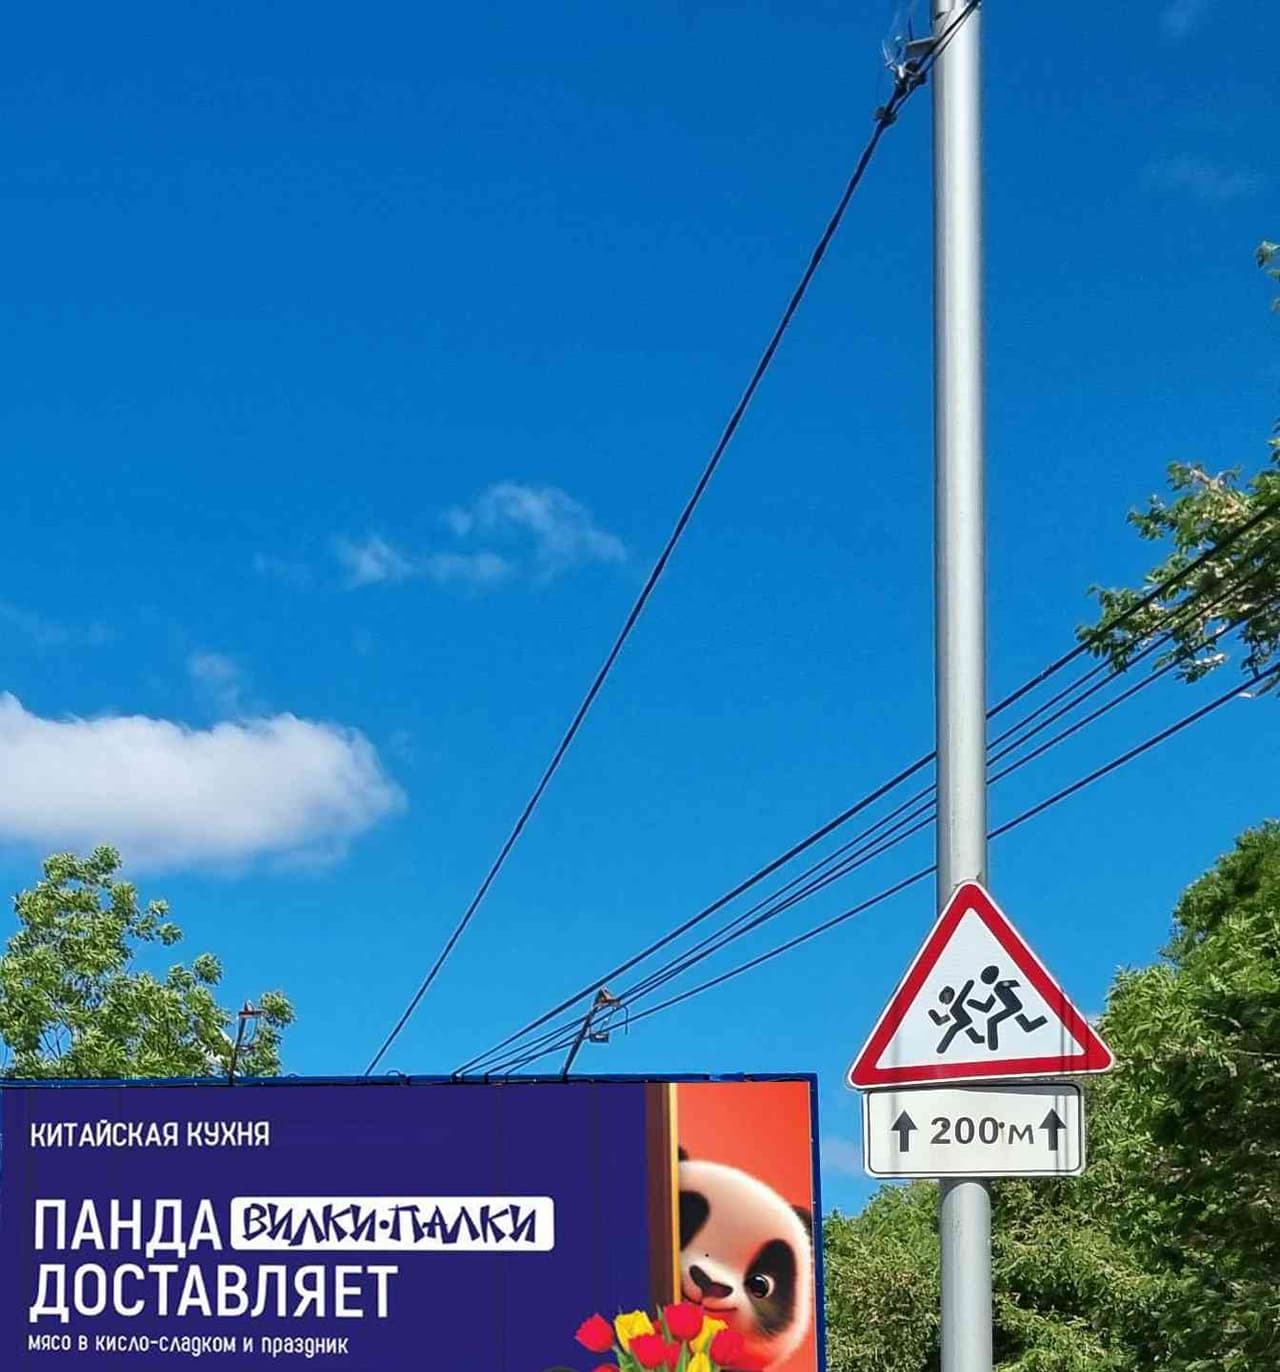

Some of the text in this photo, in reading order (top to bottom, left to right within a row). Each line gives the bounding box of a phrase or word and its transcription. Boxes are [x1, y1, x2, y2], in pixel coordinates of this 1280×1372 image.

[30, 1119, 270, 1148] КИТАЙСКАЯ КУХНЯ
[929, 1116, 1000, 1145] 200
[34, 1198, 224, 1259] ПАНДА
[28, 1263, 400, 1323] ДОСТАВЛЯЕТ
[28, 1334, 72, 1352] мясо
[95, 1335, 237, 1358] кисло-сладком
[242, 1336, 255, 1353] и
[261, 1336, 349, 1358] праздник
